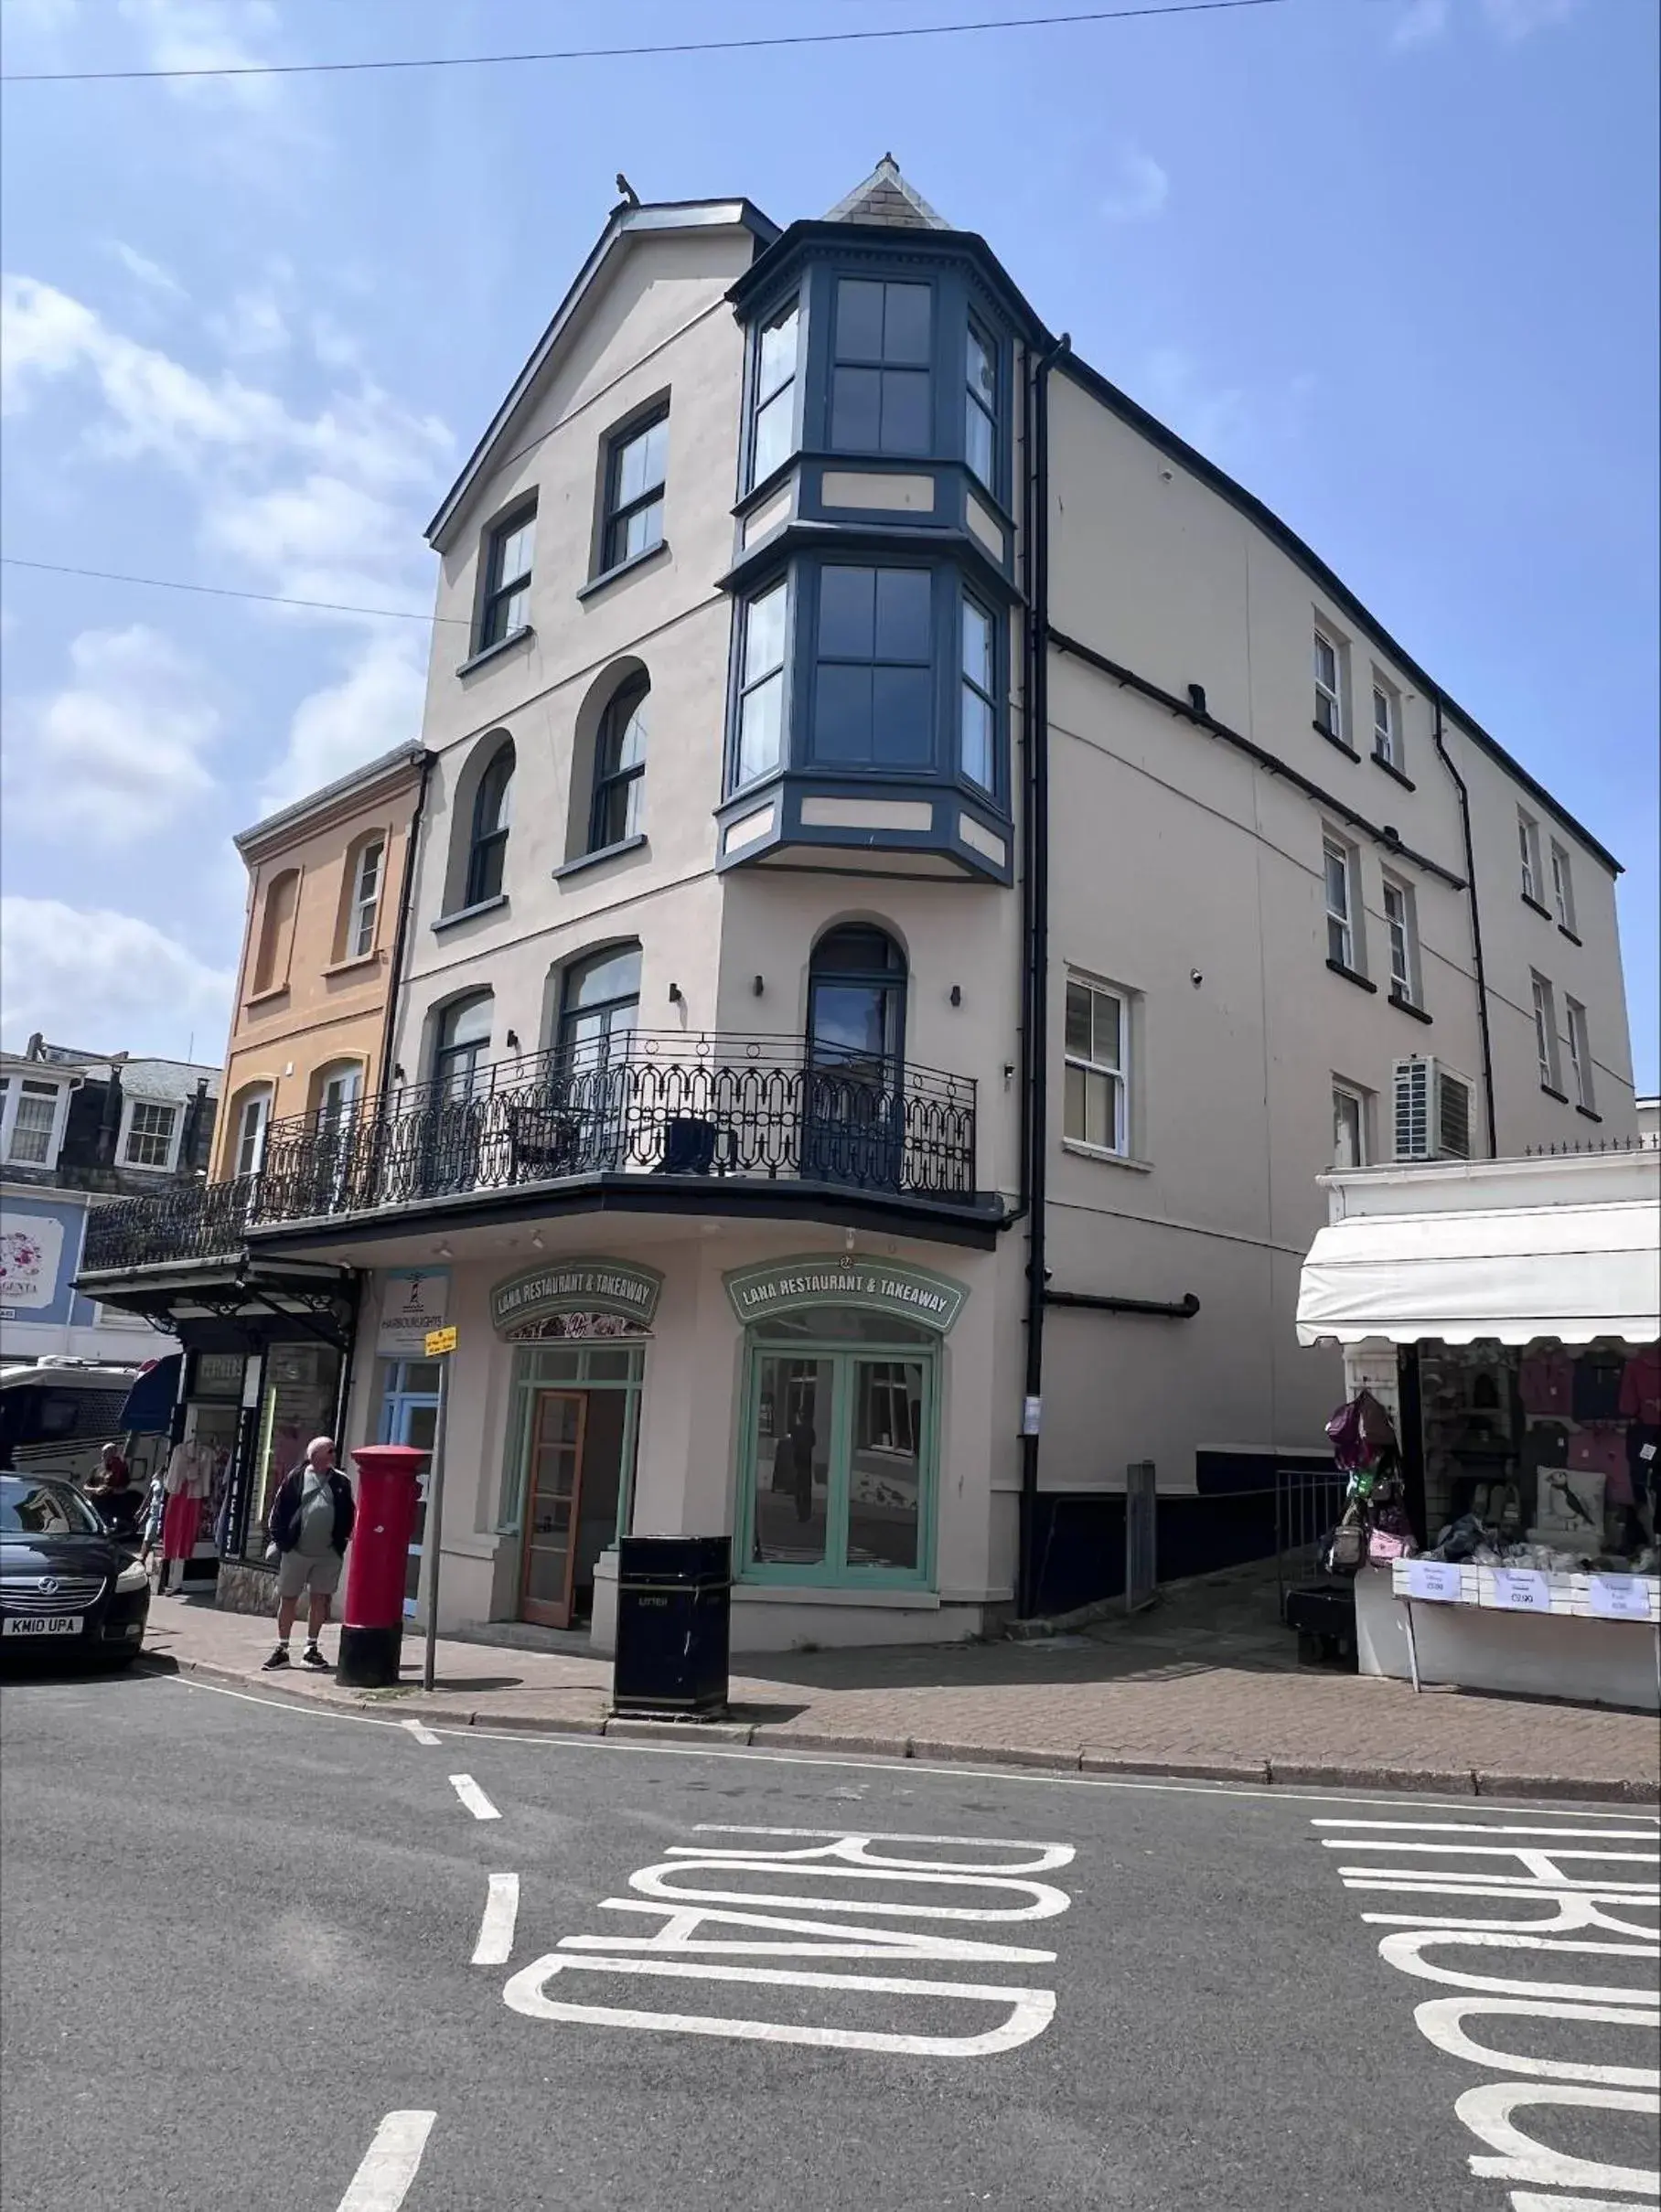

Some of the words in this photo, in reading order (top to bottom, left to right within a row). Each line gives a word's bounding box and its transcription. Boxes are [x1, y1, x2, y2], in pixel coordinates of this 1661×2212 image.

[498, 1288, 521, 1314] LANA
[523, 1274, 584, 1302] RESTAURANT
[586, 1275, 594, 1292] &
[597, 1274, 649, 1305] TAKEAWAY
[743, 1283, 776, 1306] LANA
[779, 1275, 863, 1296] RESTAURANT
[866, 1279, 876, 1293] &
[881, 1280, 948, 1313] TAKEAWAY
[12, 1619, 45, 1632] KM10
[48, 1618, 74, 1632] UPA
[502, 1824, 1077, 2057] ROAD
[1310, 1819, 1660, 2212] THRO
